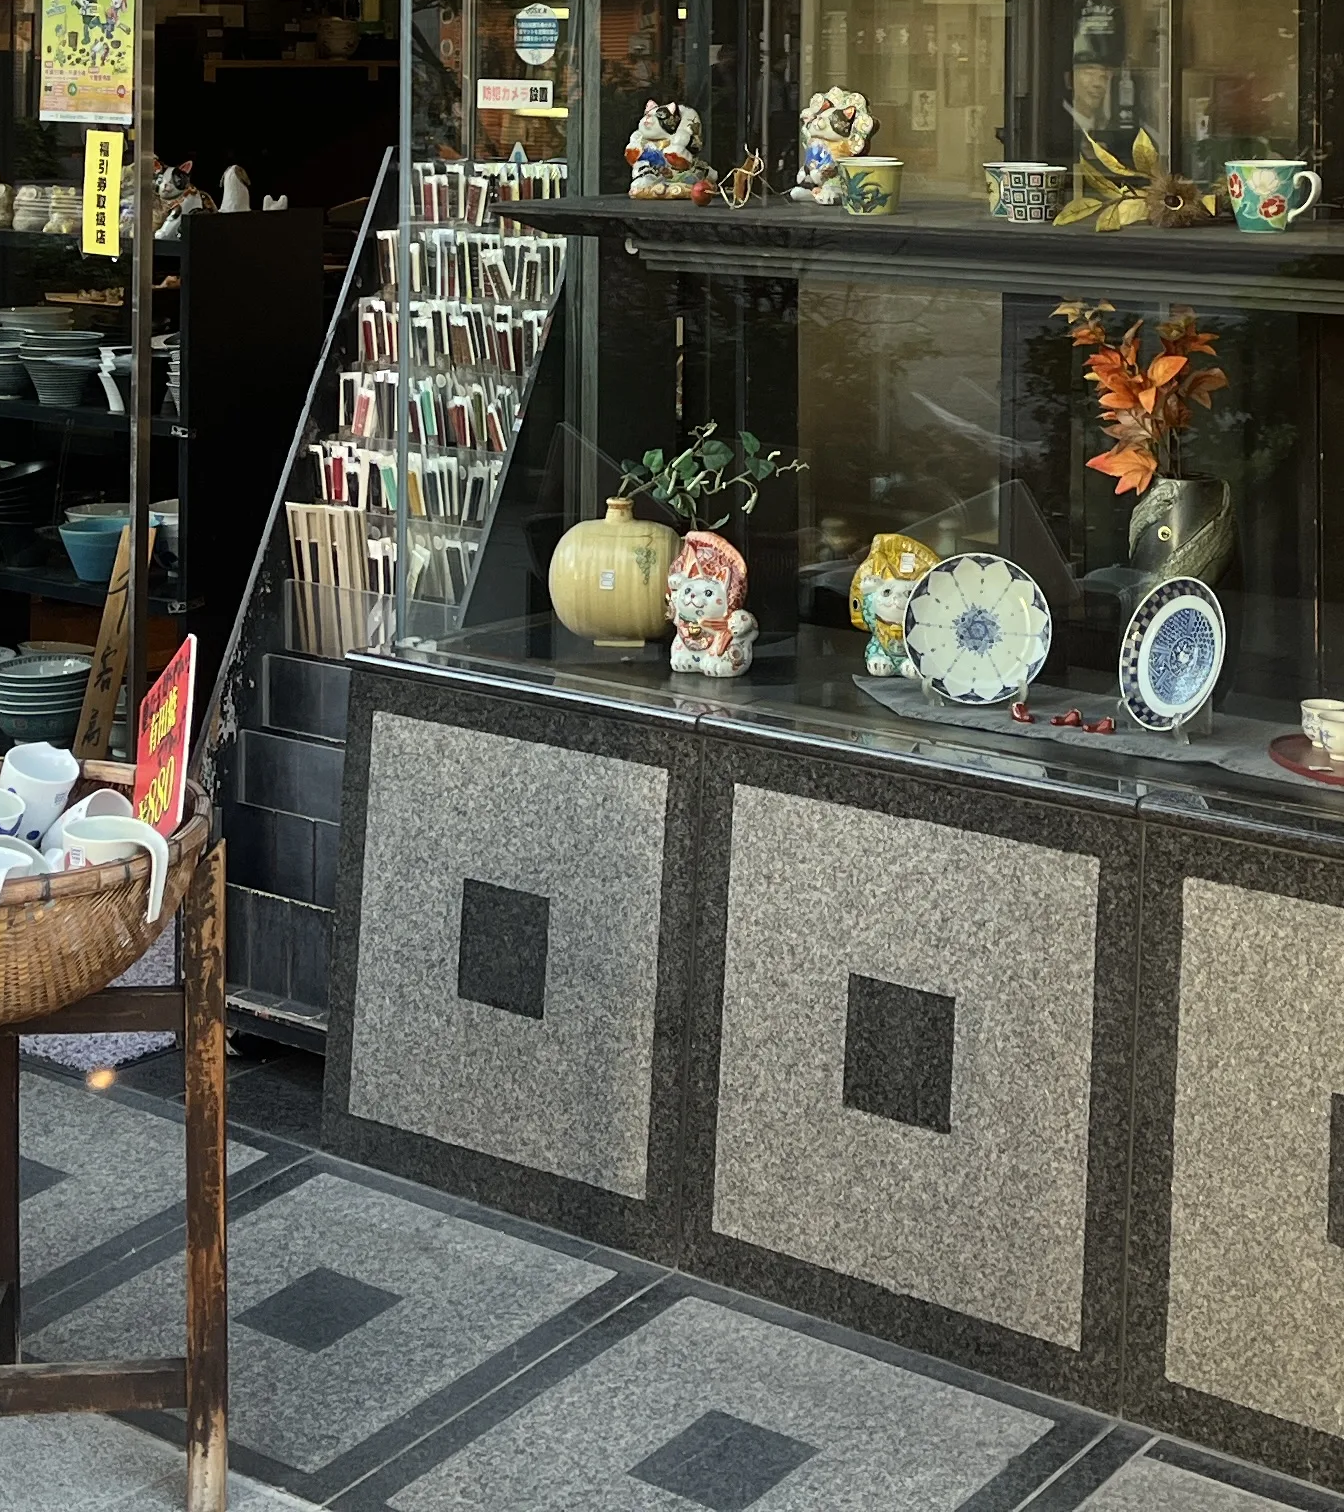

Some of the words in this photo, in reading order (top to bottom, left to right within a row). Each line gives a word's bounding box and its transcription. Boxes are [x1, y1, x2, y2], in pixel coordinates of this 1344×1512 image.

[483, 86, 548, 102] 防犯カメラ設置
[138, 756, 175, 826] ¥880
